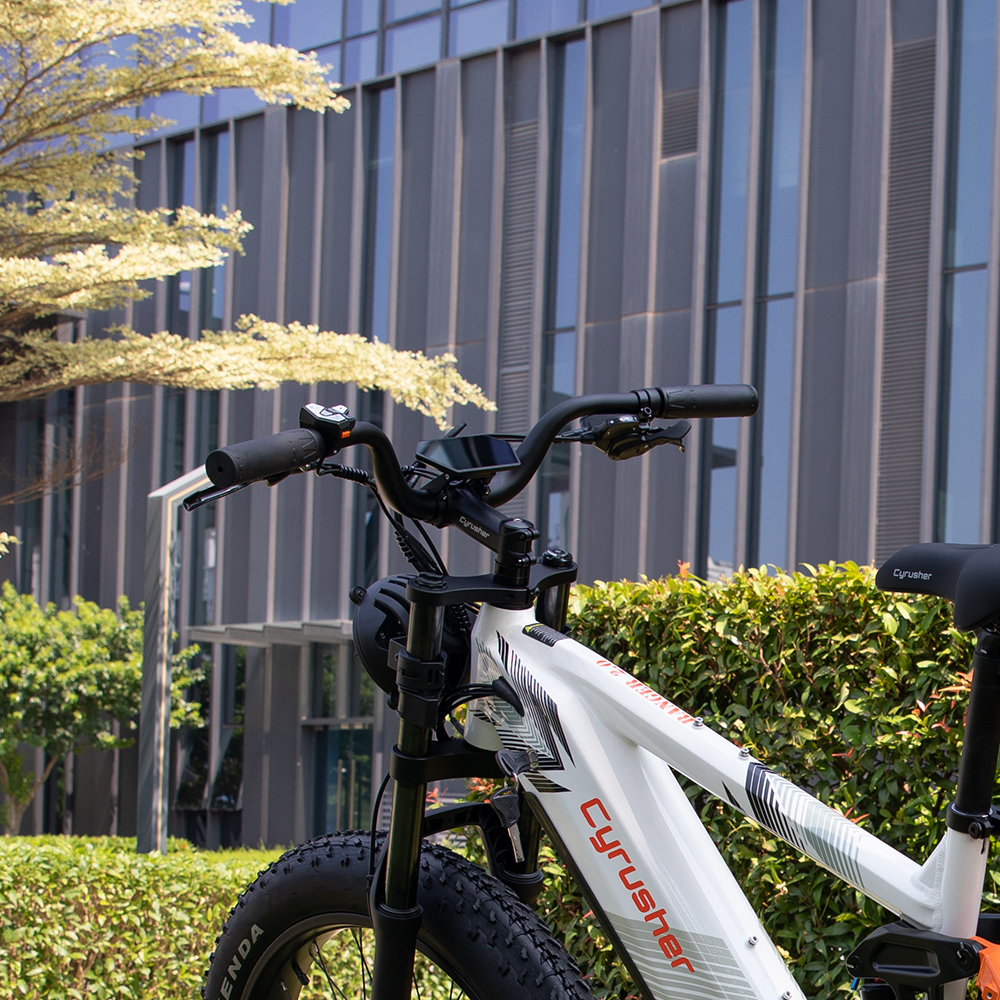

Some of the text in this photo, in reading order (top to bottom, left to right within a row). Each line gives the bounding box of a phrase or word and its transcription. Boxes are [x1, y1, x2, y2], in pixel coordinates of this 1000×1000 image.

[459, 516, 490, 538] Cyrusher
[893, 568, 932, 580] Cyrusher
[596, 660, 695, 724] RANGER 2.0
[580, 797, 695, 973] Cyrusher
